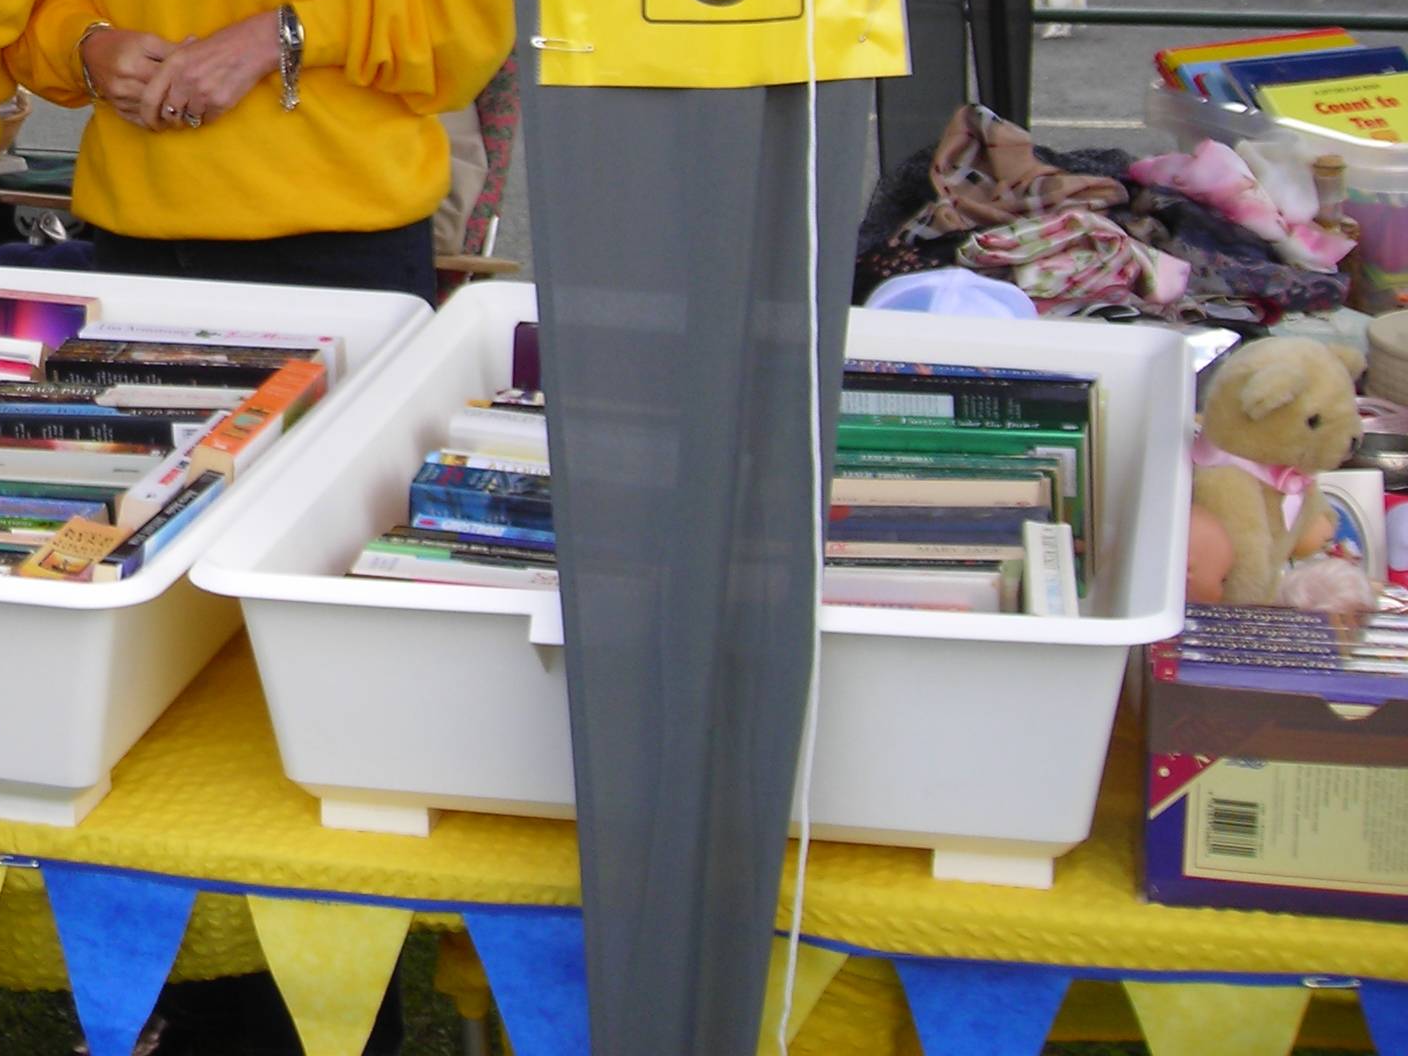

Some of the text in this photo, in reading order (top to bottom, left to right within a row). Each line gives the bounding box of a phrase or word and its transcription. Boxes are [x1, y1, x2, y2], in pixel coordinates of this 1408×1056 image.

[1313, 95, 1400, 115] Count to
[1347, 116, 1388, 129] Ten
[15, 385, 59, 395] GRACE
